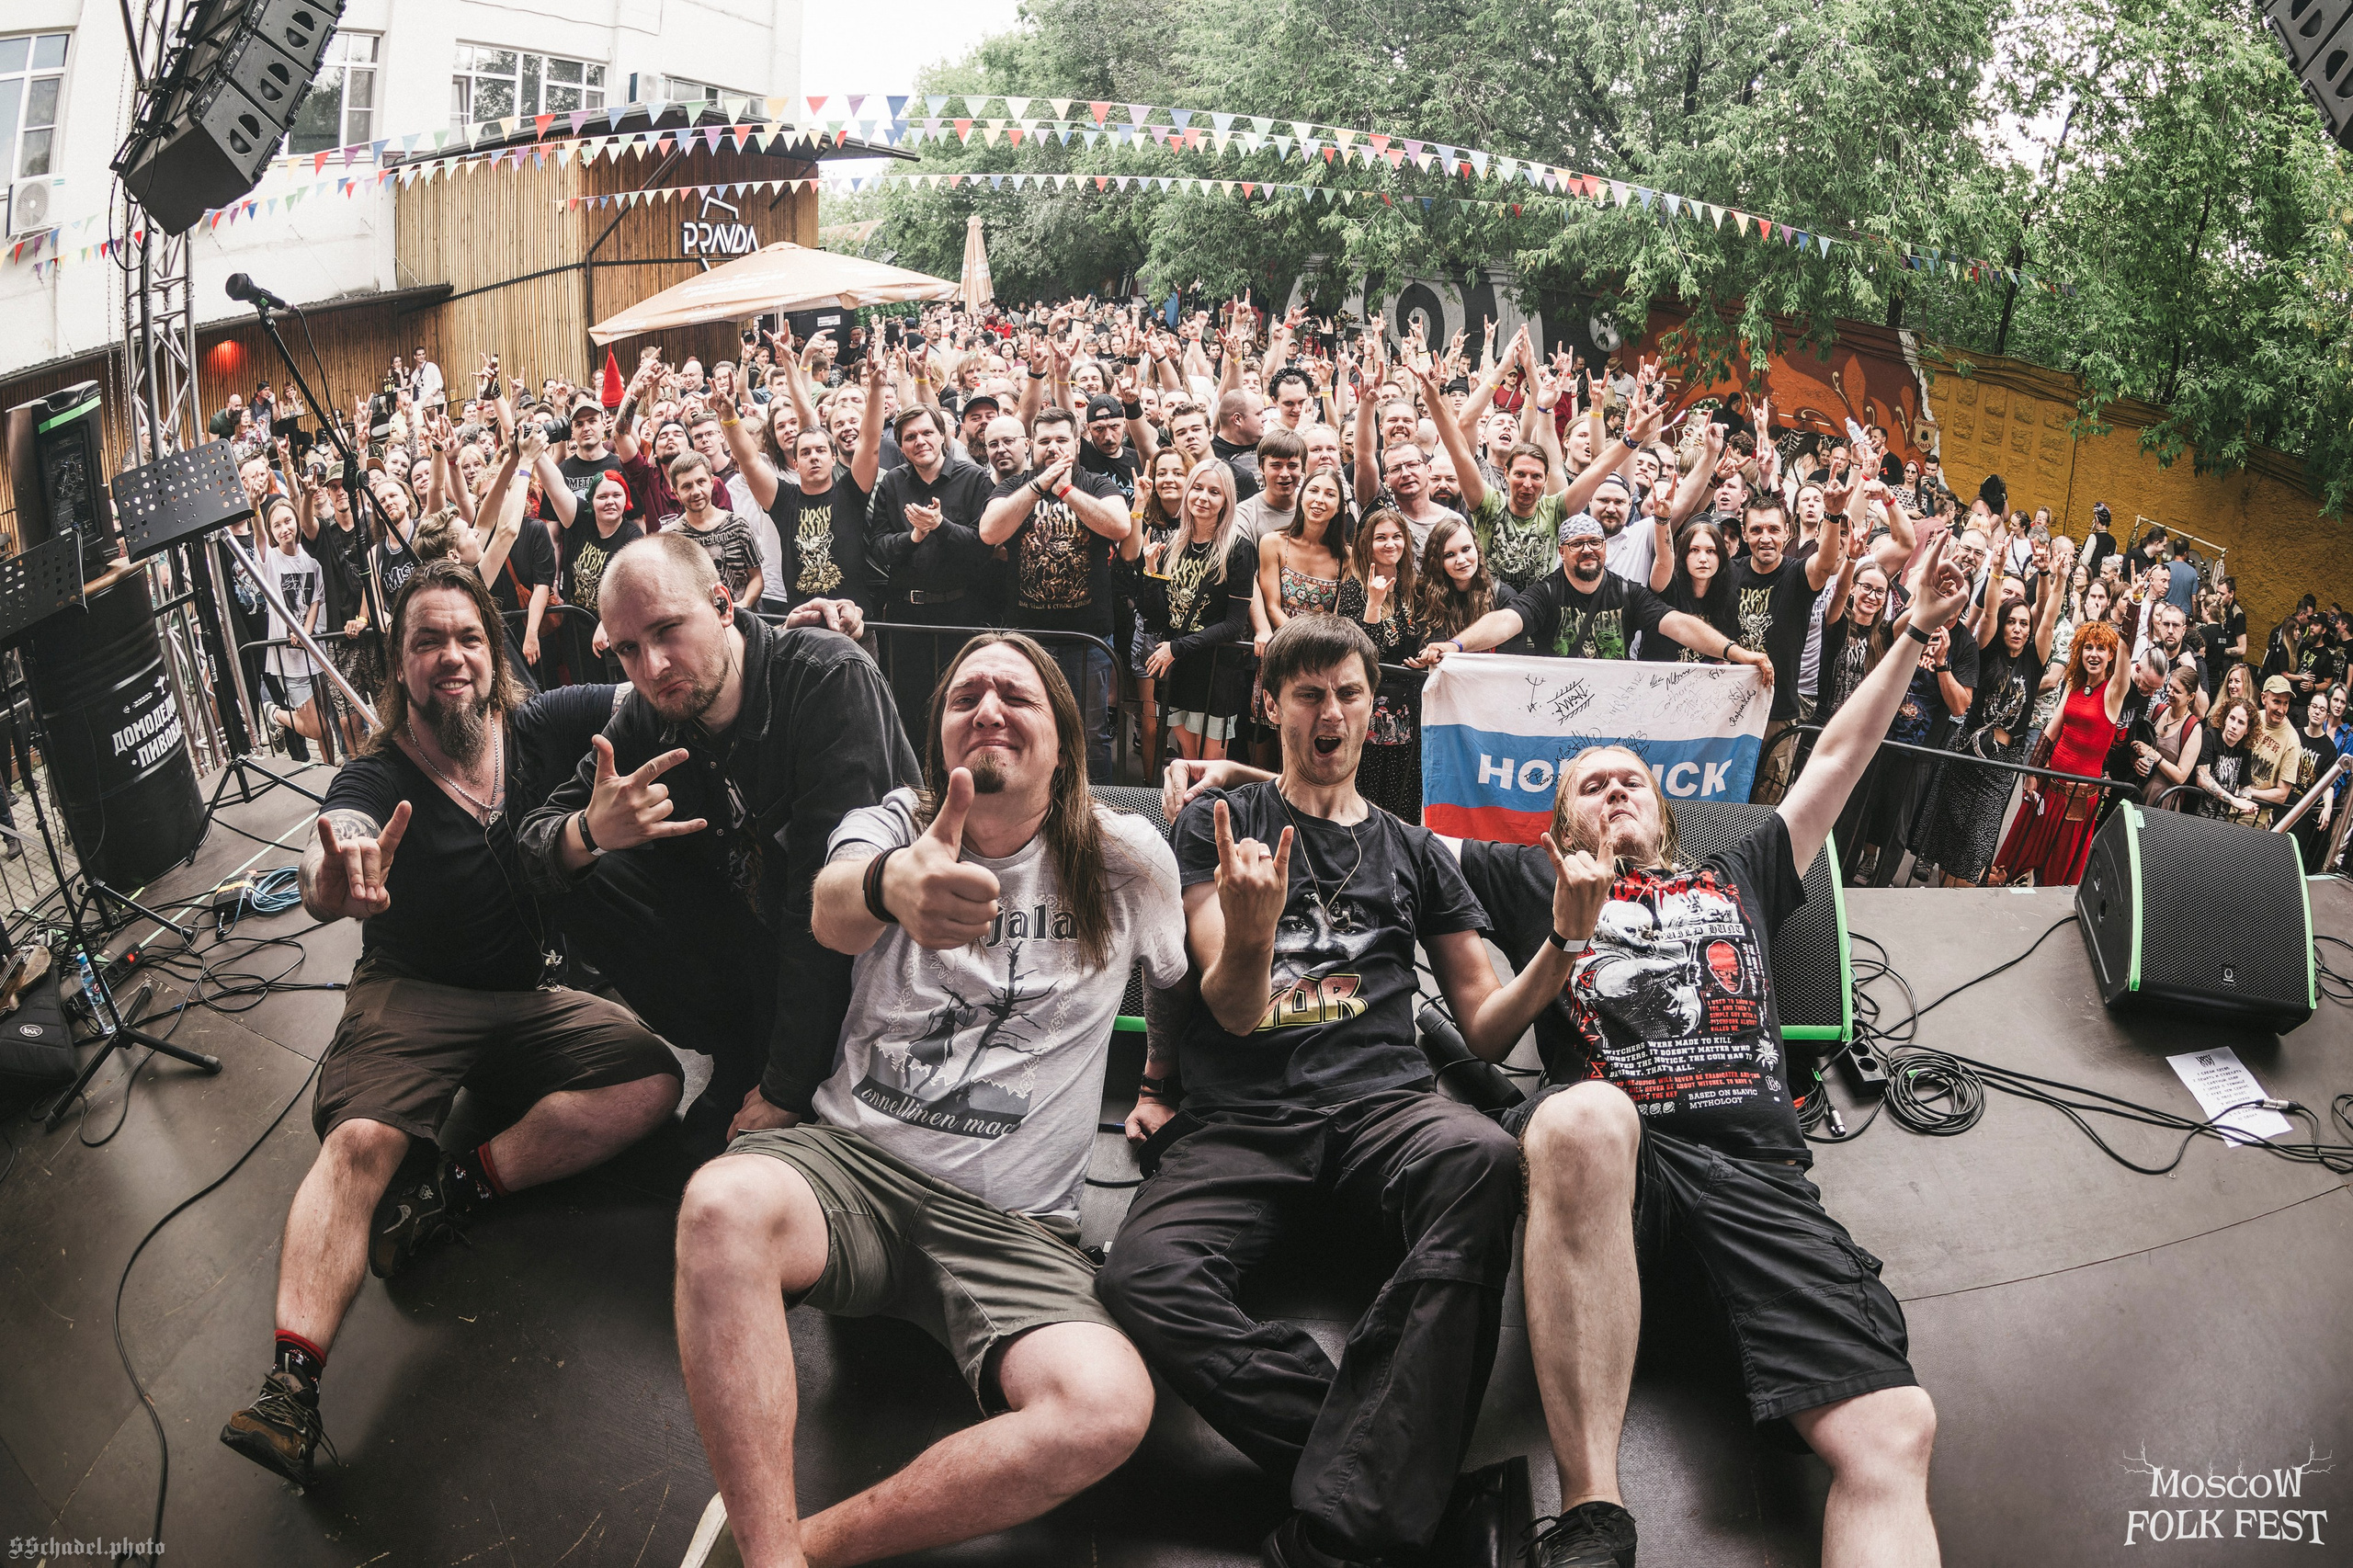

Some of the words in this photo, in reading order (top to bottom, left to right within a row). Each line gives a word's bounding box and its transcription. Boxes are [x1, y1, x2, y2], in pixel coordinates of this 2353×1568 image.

[683, 222, 760, 255] PRAVDA
[1710, 924, 1744, 936] HUNT
[1602, 1041, 1645, 1055] WITCHERS
[1675, 1039, 1699, 1047] MADE
[1713, 1036, 1732, 1044] KILL
[1660, 1046, 1695, 1055] DOESN'T
[1697, 1045, 1730, 1053] MATTER
[1731, 1044, 1751, 1052] WHO
[1637, 1059, 1653, 1068] THE
[1688, 1054, 1706, 1062] THE
[1646, 1064, 1673, 1075] THAT'S
[1675, 1063, 1695, 1073] ALL.
[1657, 1076, 1673, 1085] WILL
[1644, 1085, 1665, 1093] NEVER
[1676, 1082, 1696, 1090] ABOUT
[1665, 1090, 1678, 1098] KEY
[1688, 1090, 1716, 1101] BASED
[1718, 1089, 1731, 1097] ON
[1732, 1088, 1758, 1096] SLAVIC
[1689, 1096, 1744, 1110] MYTHOLOGY
